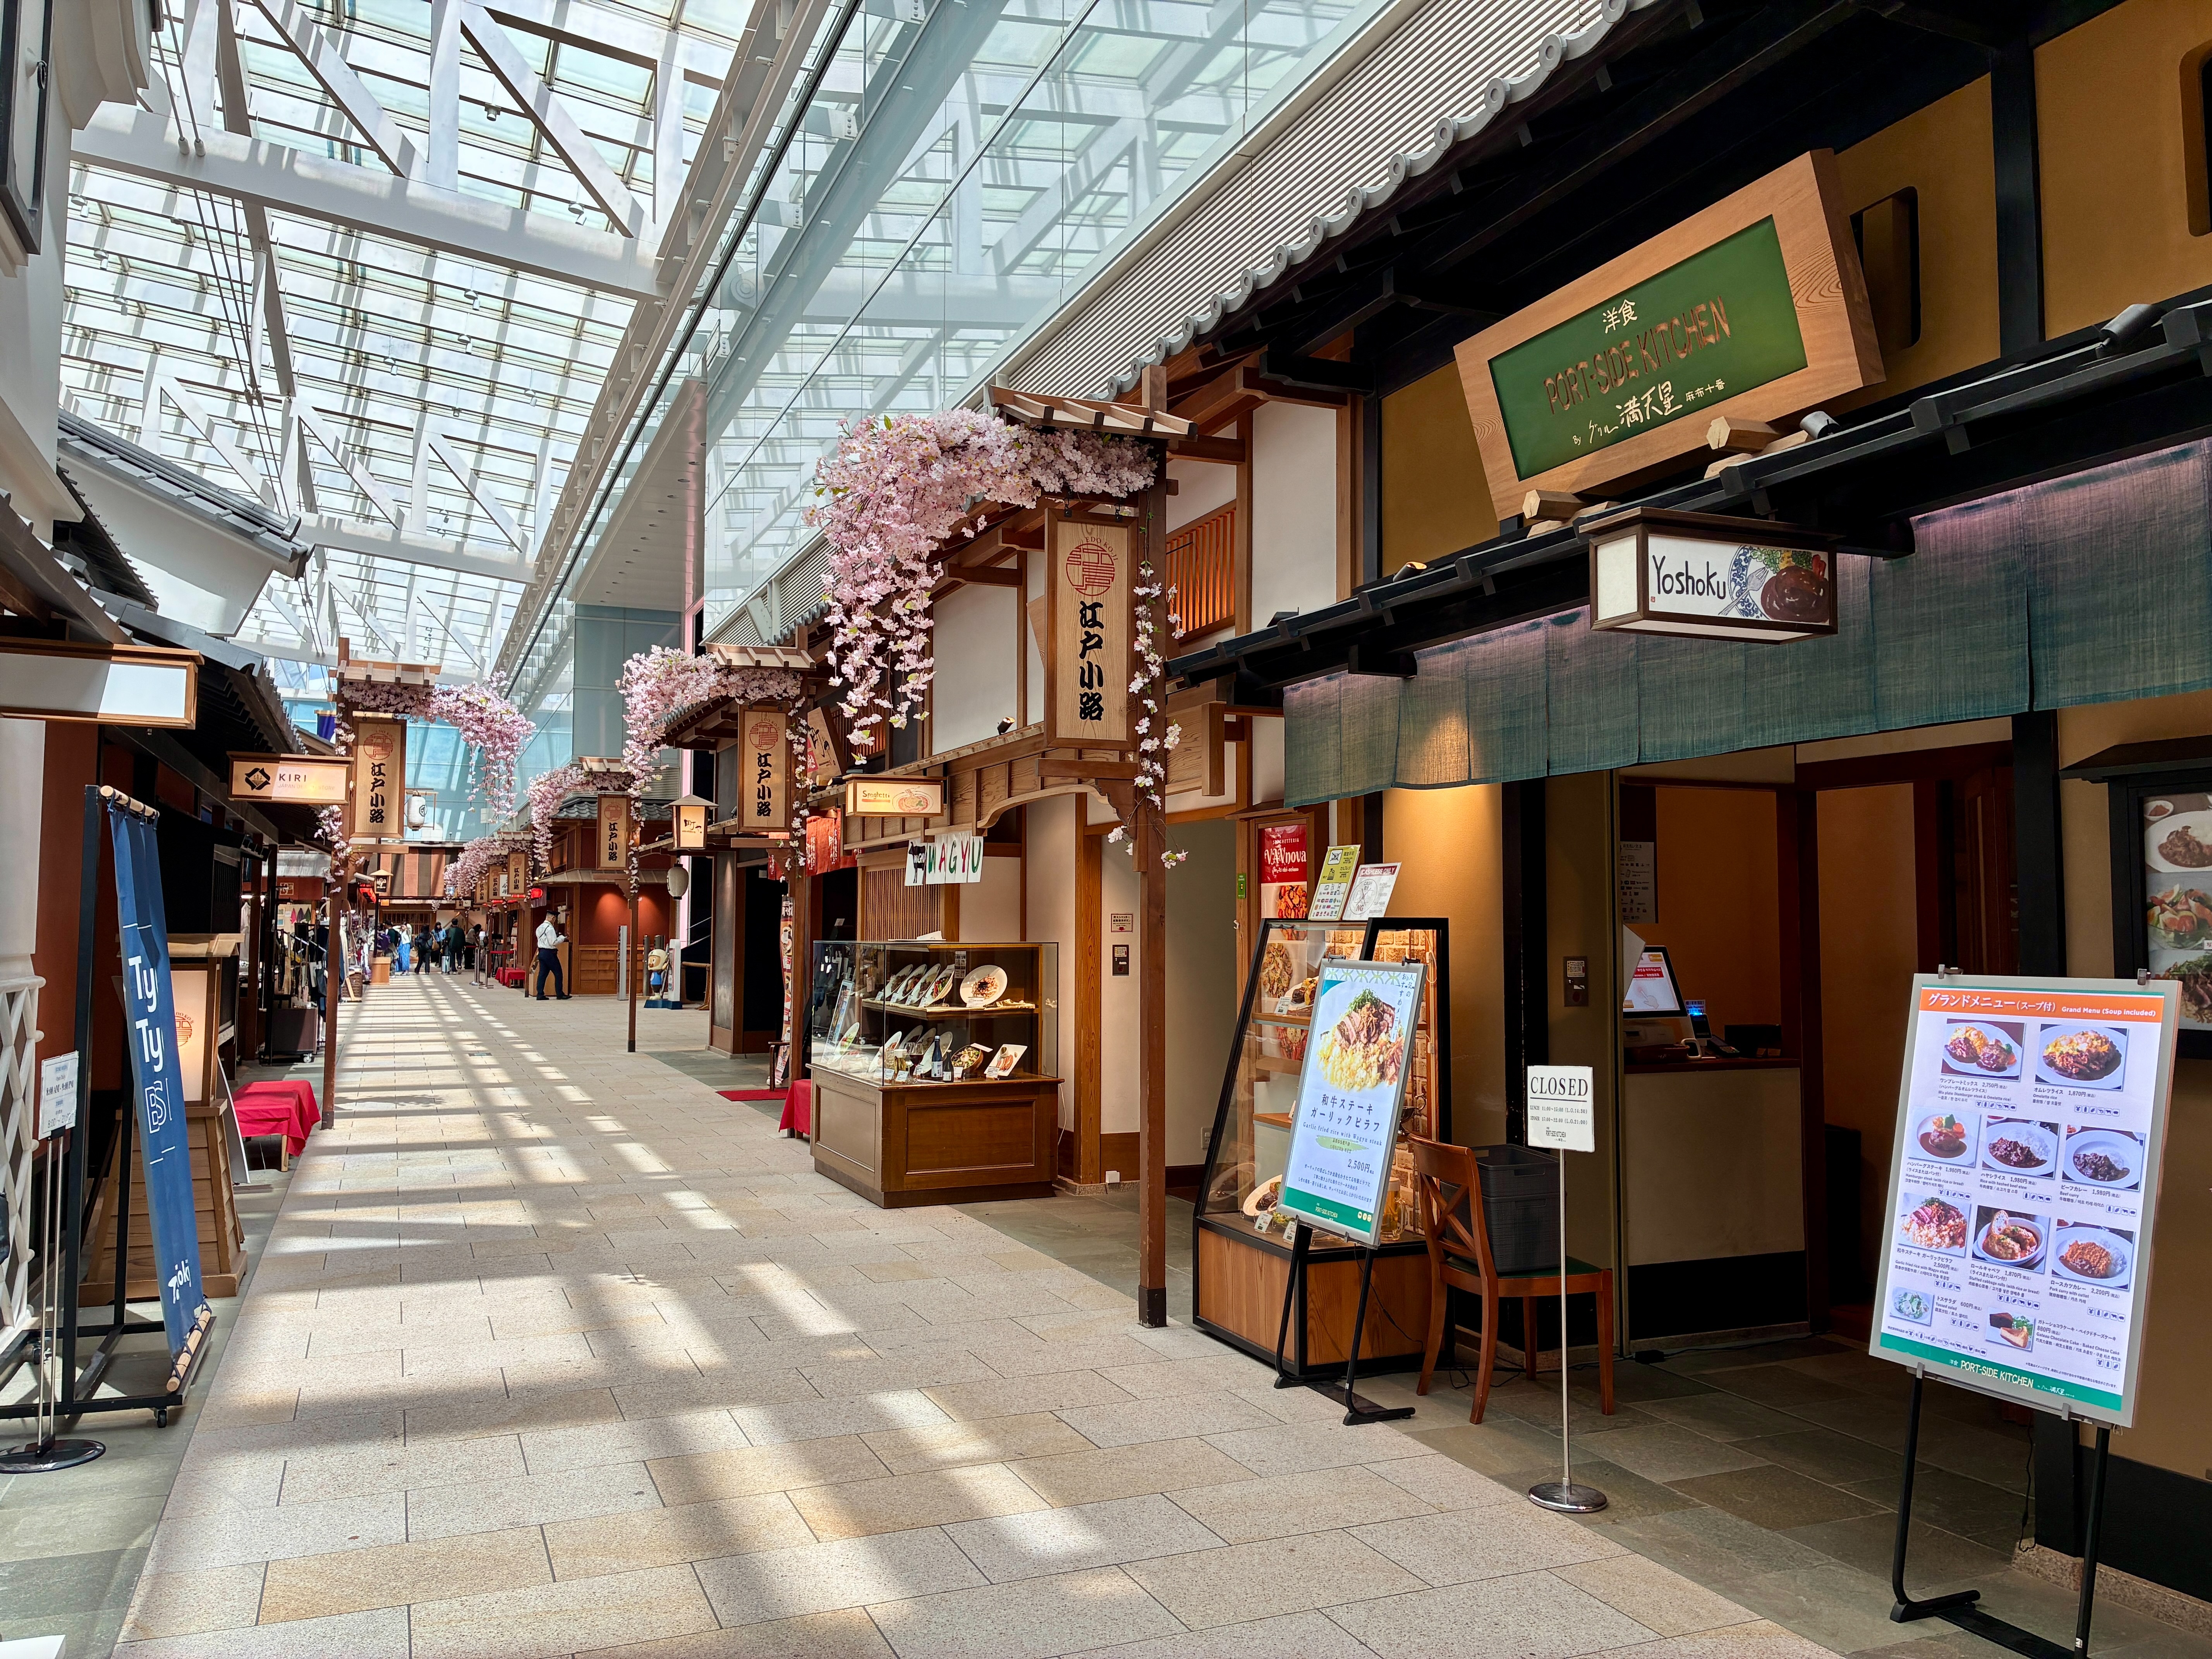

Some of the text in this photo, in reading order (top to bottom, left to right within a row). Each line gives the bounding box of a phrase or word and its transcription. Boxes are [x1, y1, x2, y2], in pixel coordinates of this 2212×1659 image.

[1602, 299, 1638, 334] 洋食
[1543, 295, 1731, 414] PORT-SIDE KITCHEN
[1573, 436, 1582, 445] By
[1685, 379, 1725, 402] 麻布十番
[1652, 555, 1726, 599] Yoshoku
[1079, 601, 1104, 721] 江戸小路
[279, 774, 306, 782] KIRI
[757, 753, 772, 817] 江戸小路
[369, 763, 386, 823] 江戸小路
[863, 790, 890, 799] Spaghetti
[608, 822, 618, 861] 江戸小路
[929, 838, 981, 874] WAGYU
[2102, 1008, 2122, 1017] (Soup
[2123, 1008, 2156, 1017] included)
[1531, 1077, 1588, 1096] CLOSED
[1321, 1094, 1373, 1115] 和牛ステーキ
[1311, 1107, 1380, 1132] ガーリックピラフ
[1353, 1134, 1367, 1144] Wagyu
[1907, 1162, 1942, 1171] ハンバーグステーキ
[1922, 1253, 1953, 1263] ガーリックピラフ
[1971, 1264, 2000, 1274] ロールキャベツ
[2051, 1280, 2087, 1291] ロースカツカレー
[1937, 1296, 1957, 1304] トスサラダ
[1961, 1360, 1999, 1379] PORT-SIDE
[1999, 1370, 2034, 1388] KITCHEN
